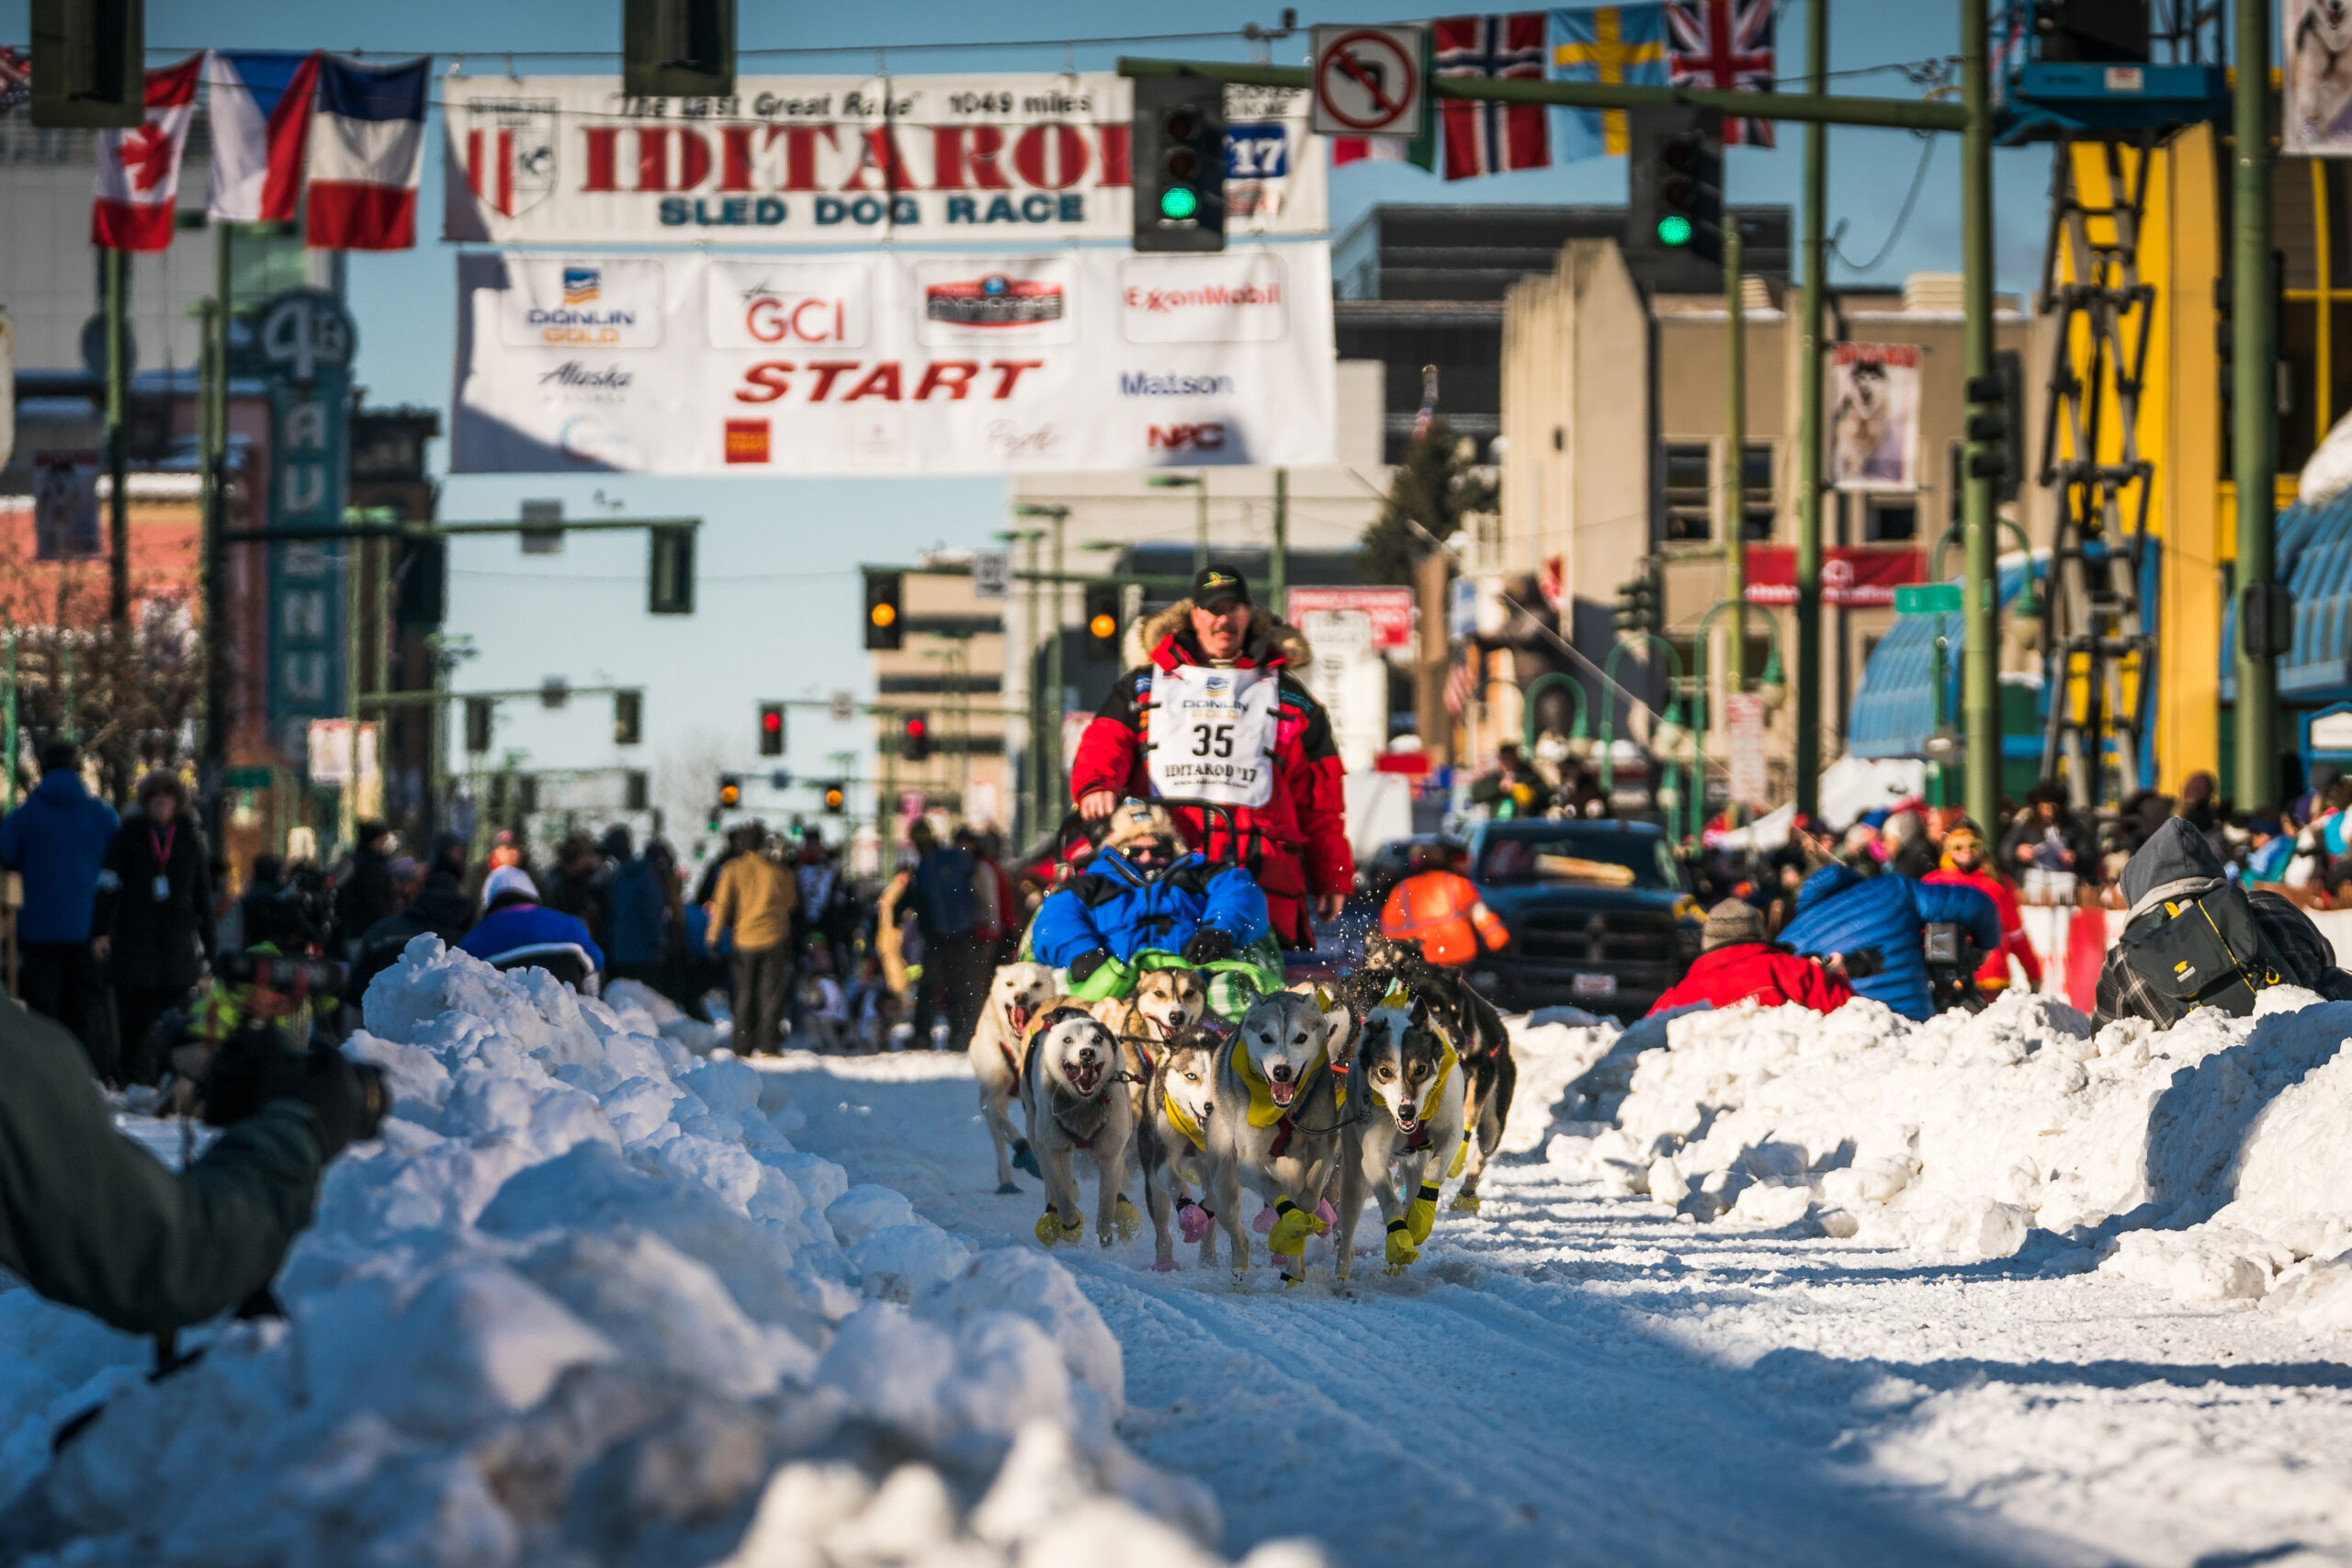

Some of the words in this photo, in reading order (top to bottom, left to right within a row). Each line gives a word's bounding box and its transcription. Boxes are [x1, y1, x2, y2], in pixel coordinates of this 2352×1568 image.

[753, 93, 831, 116] Great
[949, 91, 1014, 113] 1049
[1022, 89, 1093, 113] miles
[658, 196, 787, 226] SLED
[813, 194, 921, 226] DOG
[946, 193, 1085, 224] RACE
[527, 308, 636, 325] DONLIN
[745, 296, 844, 344] GCI
[542, 327, 621, 344] GOLD
[537, 359, 635, 389] Alaska
[733, 359, 1045, 404] START
[1182, 699, 1250, 713] DONLIN
[1192, 709, 1240, 720] GOLD
[1192, 723, 1235, 758] 35
[1164, 762, 1235, 778] IDITAROD
